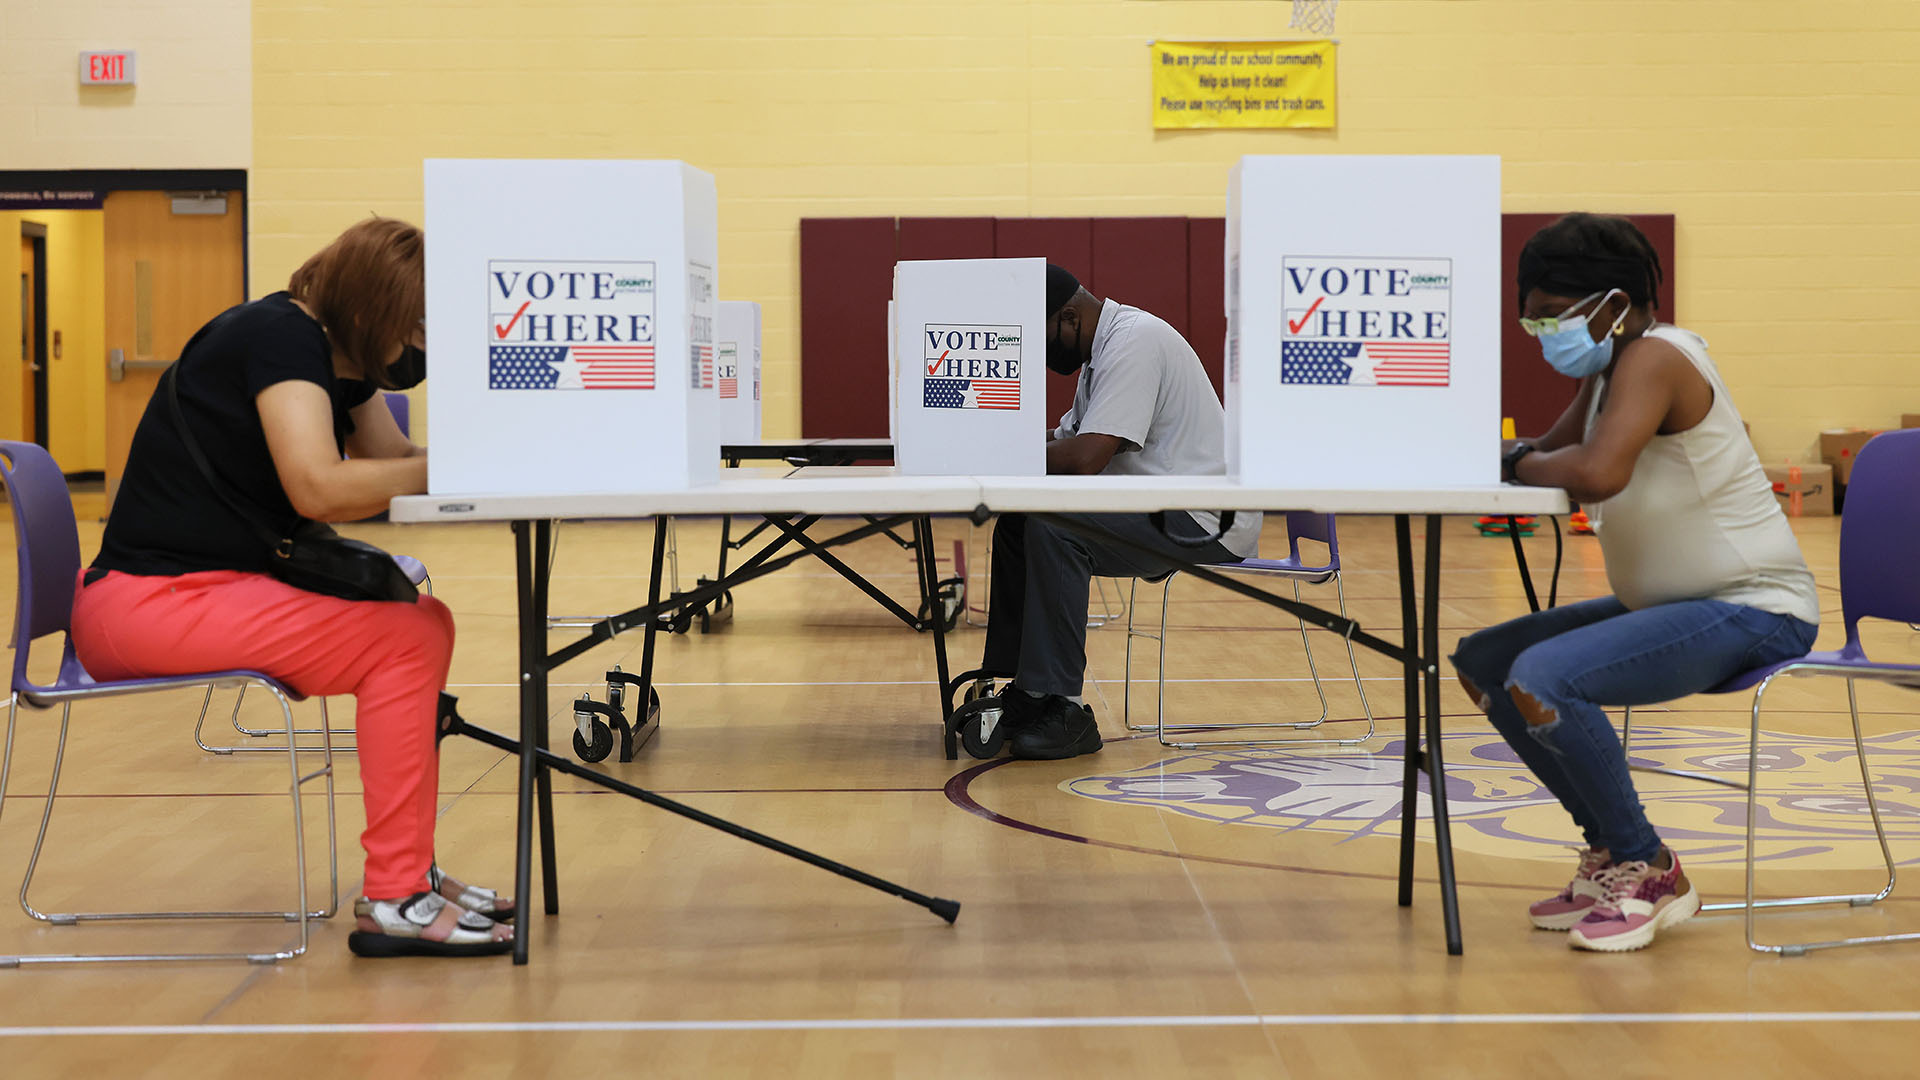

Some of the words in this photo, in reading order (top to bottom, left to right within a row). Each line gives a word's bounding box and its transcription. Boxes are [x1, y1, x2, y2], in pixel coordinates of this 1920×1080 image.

[90, 54, 127, 81] EXIT
[1161, 52, 1174, 65] We
[1177, 56, 1189, 65] are
[1192, 53, 1216, 68] proud
[1219, 51, 1228, 65] of
[1231, 55, 1244, 65] our
[1247, 52, 1273, 65] school
[1199, 75, 1217, 91] Help
[1220, 78, 1229, 88] us
[1232, 75, 1250, 91] keep
[1254, 75, 1261, 87] it
[1262, 75, 1288, 88] clean!
[1160, 97, 1186, 110] Please
[1189, 100, 1203, 110] use
[1205, 97, 1242, 114] recycling
[1244, 97, 1261, 110] bins
[1264, 97, 1280, 110] and
[1282, 97, 1303, 110] trash
[493, 271, 615, 300] VOTE
[615, 279, 652, 288] COUNTY
[1287, 267, 1410, 296] VOTE
[1410, 275, 1449, 284] COUNTY
[527, 314, 652, 342] HERE
[1319, 310, 1447, 339] HERE
[927, 331, 998, 350] VOTE
[945, 358, 1020, 378] HERE
